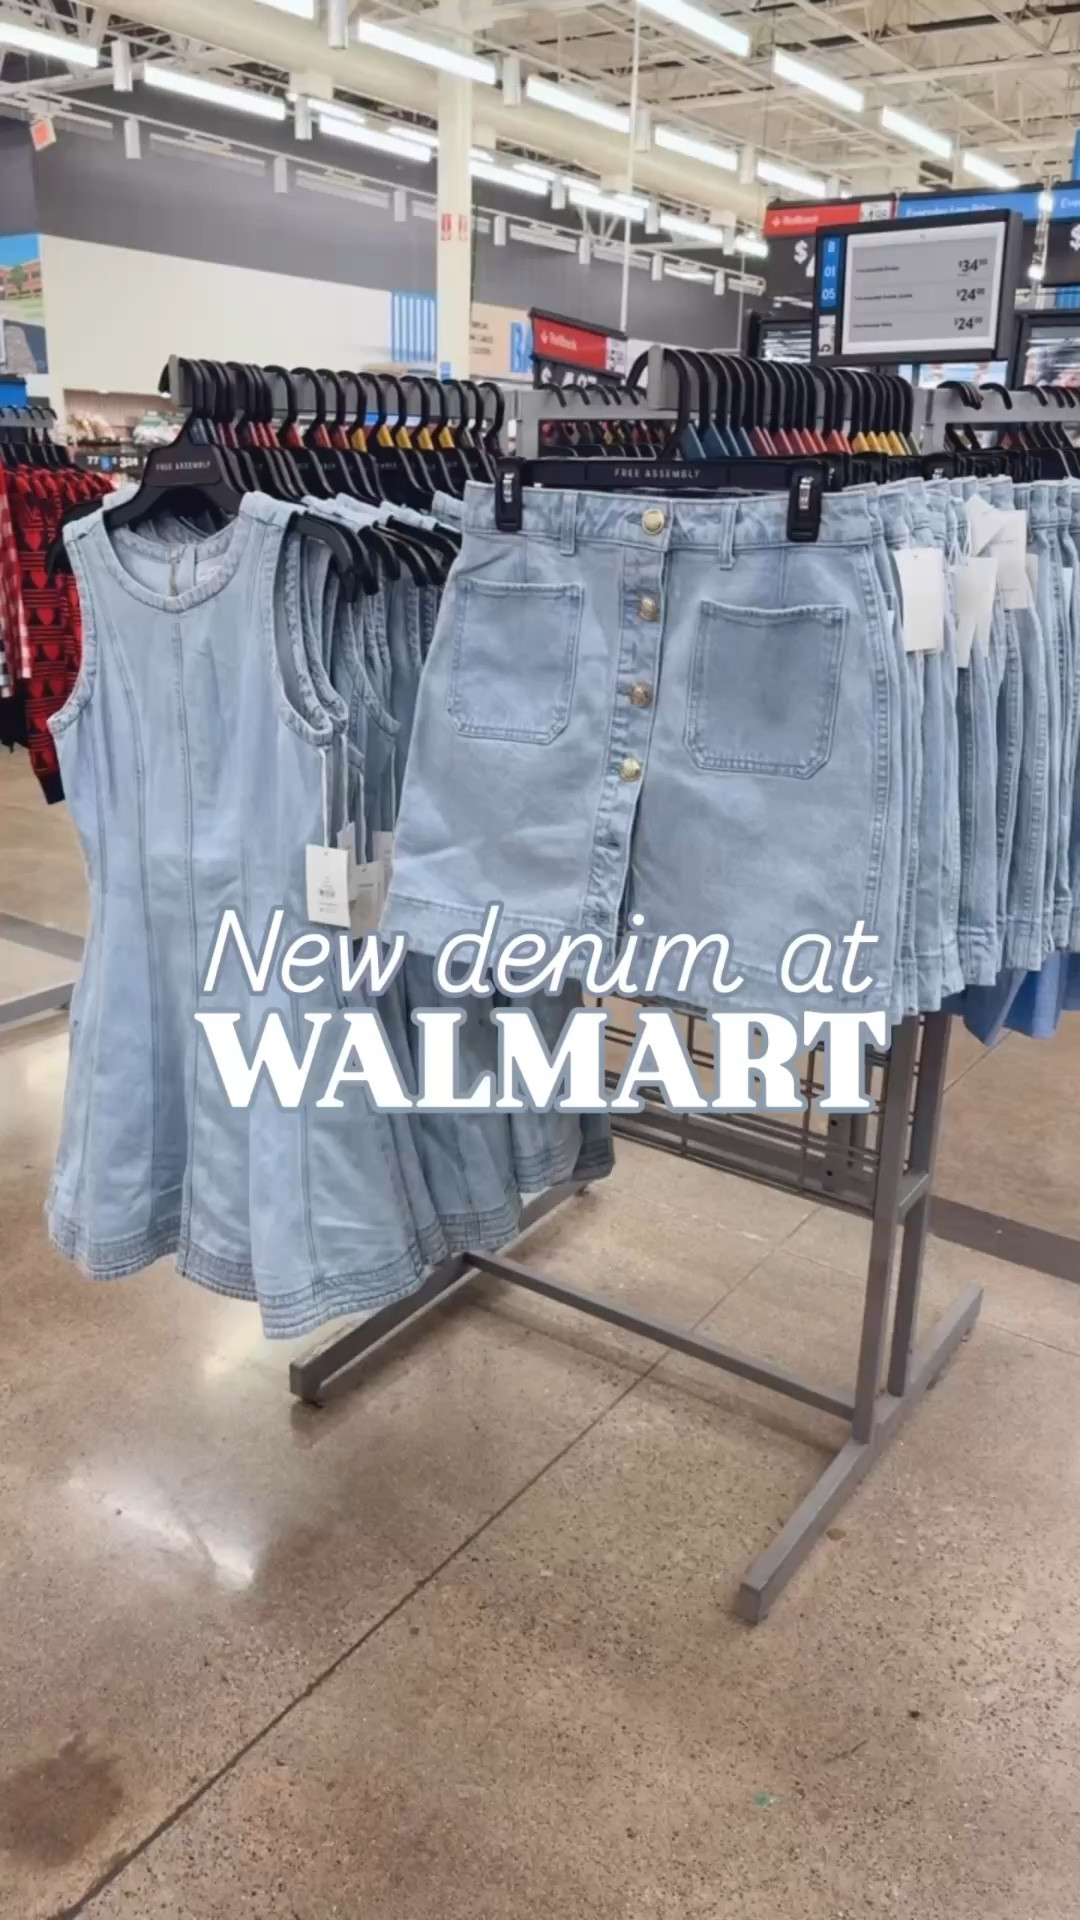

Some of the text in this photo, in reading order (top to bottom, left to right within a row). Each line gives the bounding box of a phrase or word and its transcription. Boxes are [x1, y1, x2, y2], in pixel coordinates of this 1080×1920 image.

[821, 287, 837, 301] 05
[614, 467, 701, 479] FREE ASSEMBLY
